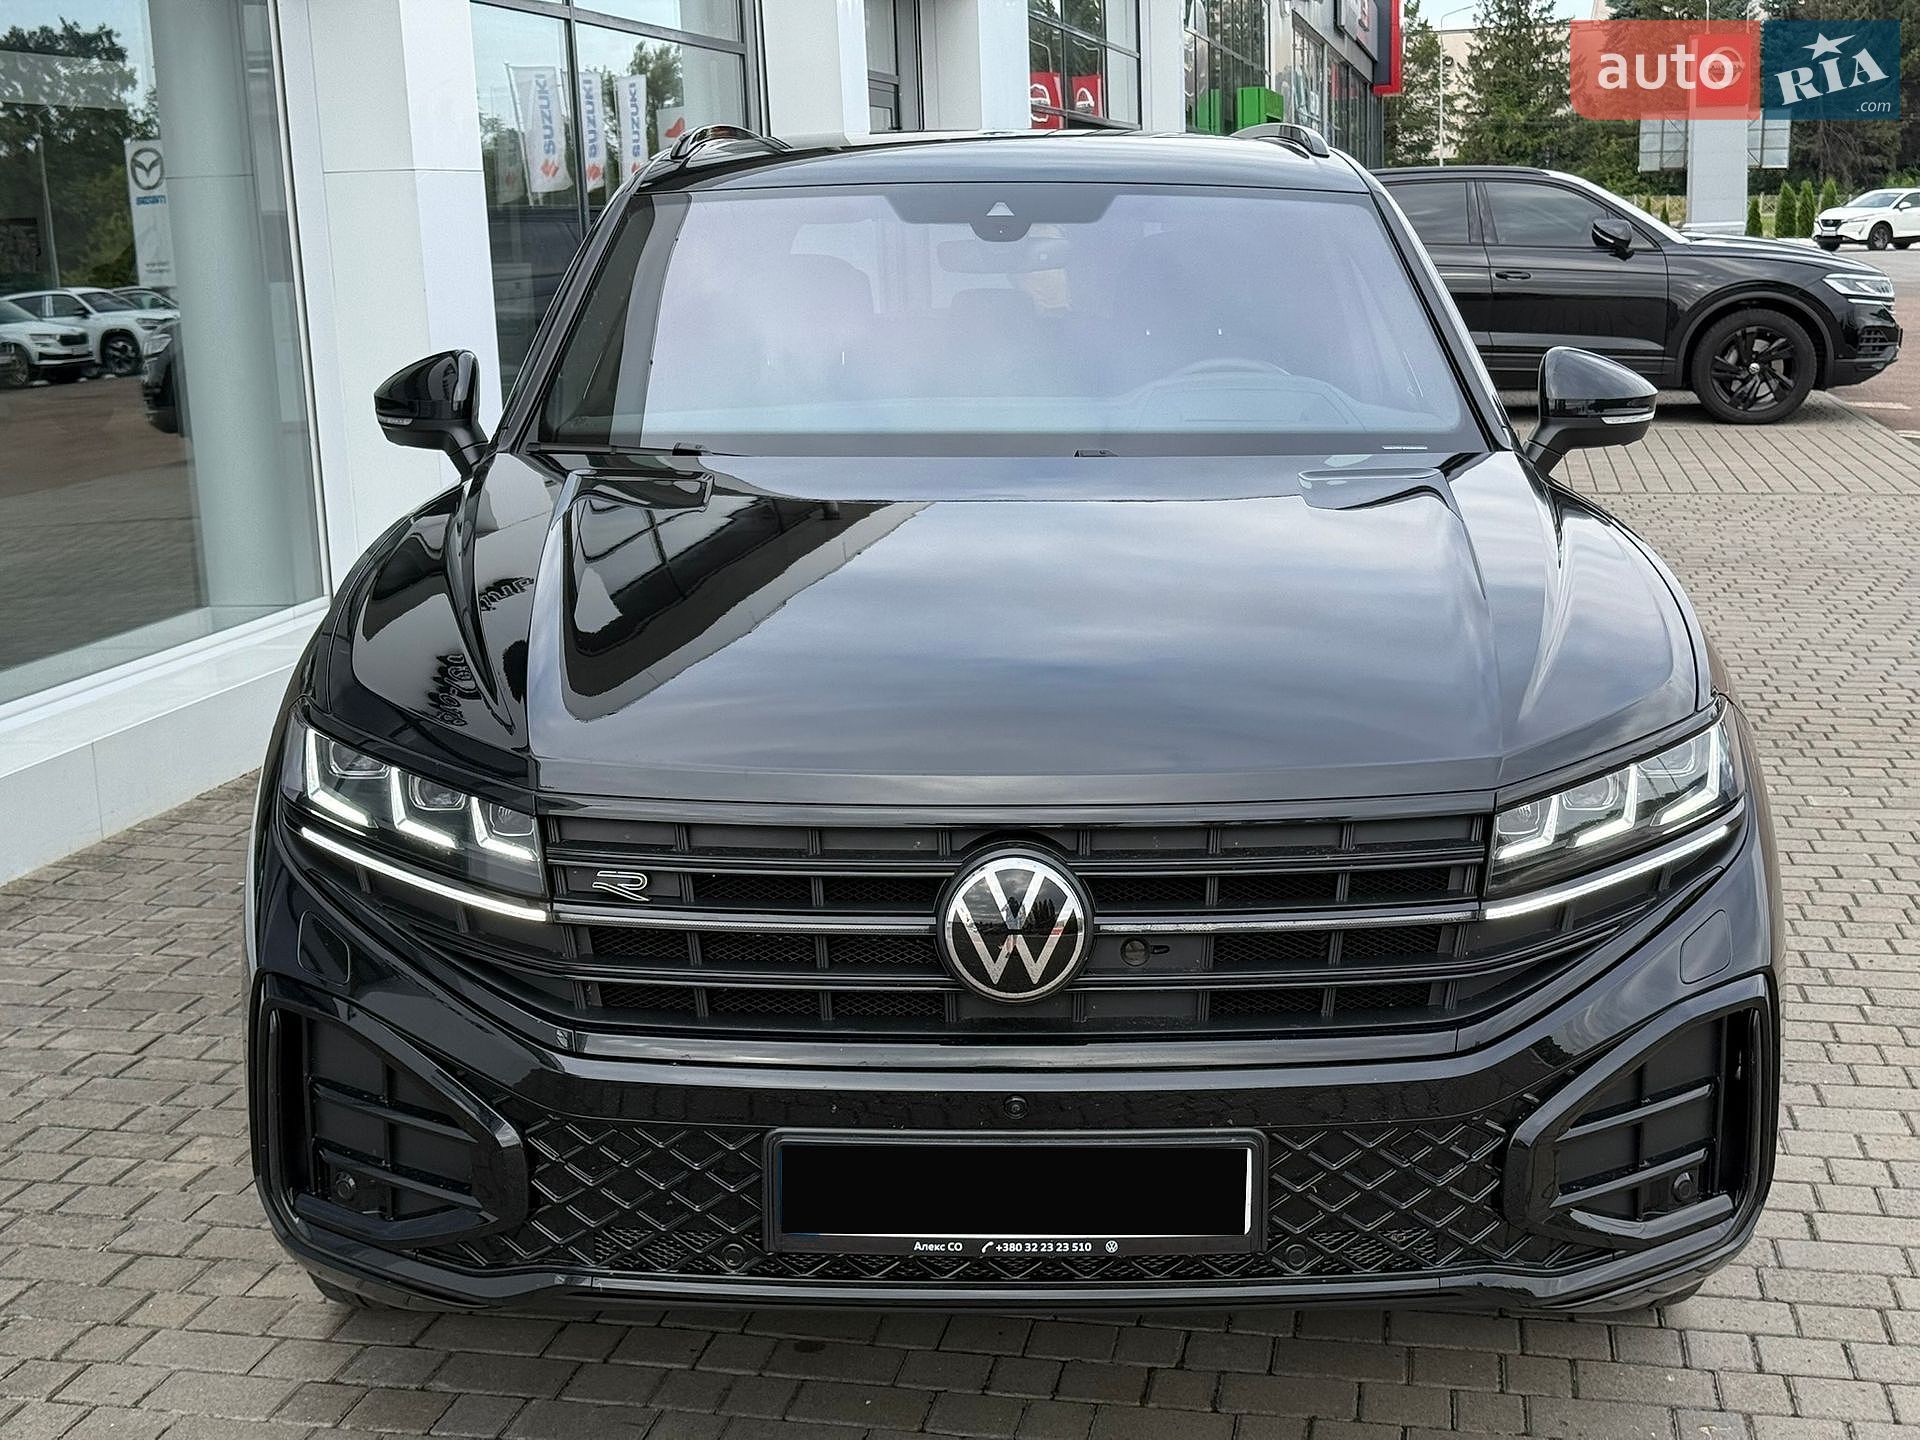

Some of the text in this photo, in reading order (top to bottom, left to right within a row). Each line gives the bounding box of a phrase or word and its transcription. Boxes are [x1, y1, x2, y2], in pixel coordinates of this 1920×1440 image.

[535, 74, 556, 155] SUZUKI
[582, 79, 598, 158] SUZUKI
[628, 83, 641, 158] SUZUKI
[913, 1241, 946, 1251] Алекс
[995, 1242, 1092, 1252] +380 32 23 23 510
